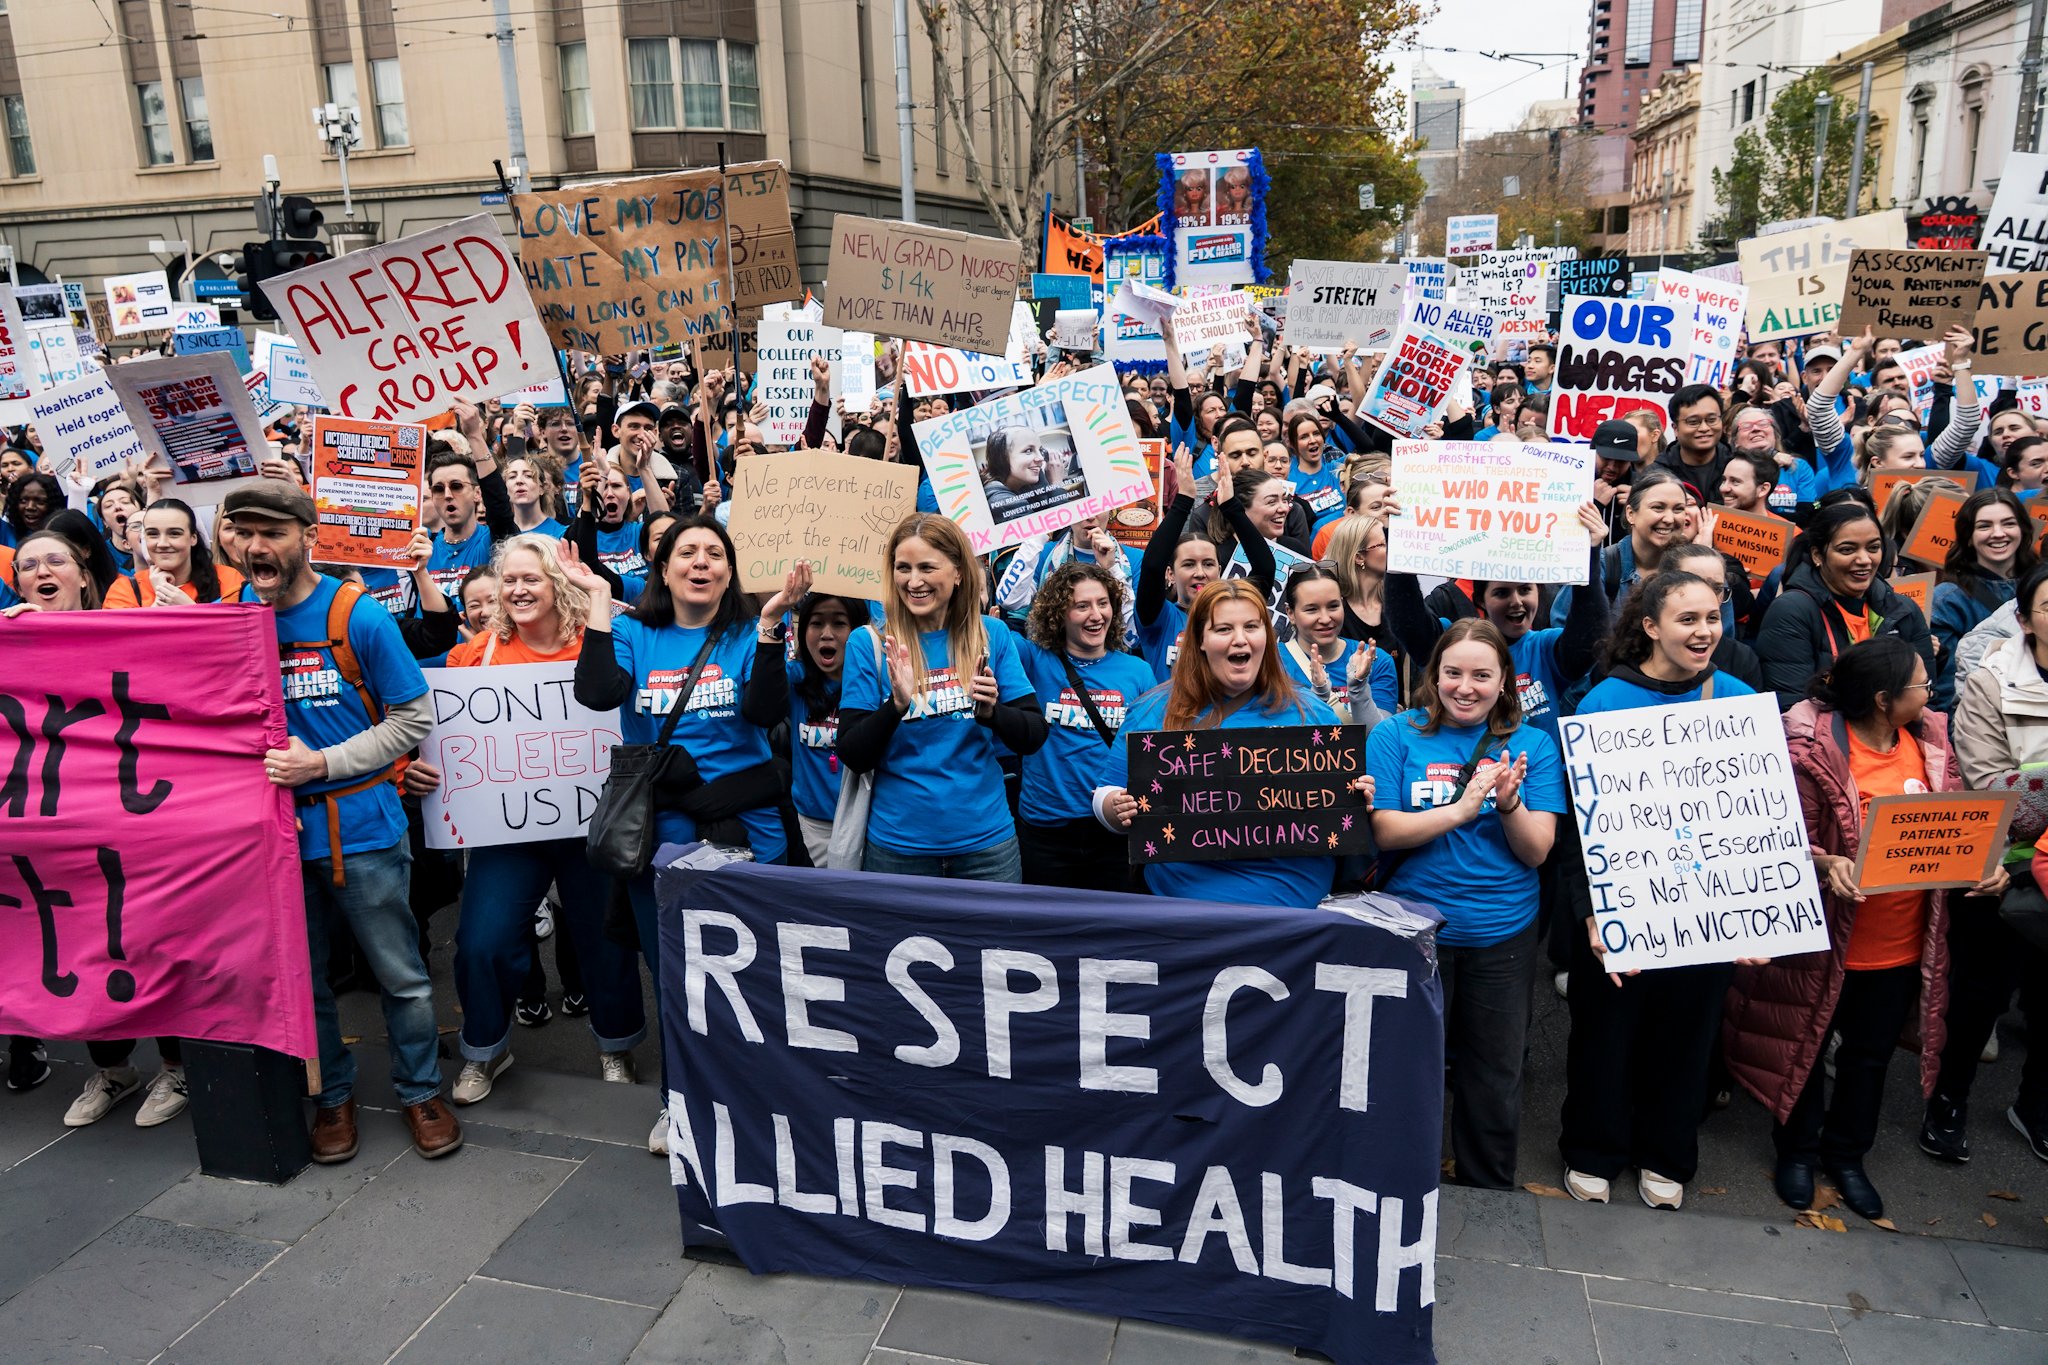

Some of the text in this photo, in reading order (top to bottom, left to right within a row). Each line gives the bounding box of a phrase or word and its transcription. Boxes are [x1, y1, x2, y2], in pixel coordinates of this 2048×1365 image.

[515, 186, 722, 239] LOVE MY JOB
[1220, 214, 1240, 225] 19%
[1216, 242, 1241, 251] ALLIED
[1216, 248, 1242, 257] HEALTH
[526, 236, 720, 291] HATE MY PAY
[843, 233, 1016, 282] NEW GRAD NURSES
[1481, 253, 1496, 265] Do
[1850, 251, 1984, 273] ASSESSMENT:
[1481, 267, 1525, 279] what an
[1561, 258, 1620, 279] BEHIND
[1428, 275, 1445, 287] PAY
[1561, 276, 1611, 295] EVERY
[1797, 275, 1826, 296] IS
[287, 236, 509, 354] ALFRED
[1202, 294, 1245, 310] PATIENTS
[1313, 287, 1376, 307] STRETCH
[1423, 289, 1444, 300] BILLS
[1480, 297, 1507, 306] This
[1858, 295, 1961, 308] PLAN NEEDS
[587, 288, 693, 324] LONG CAN
[837, 296, 934, 326] MORE THAN
[1226, 306, 1247, 319] OUR
[1414, 303, 1494, 327] NO ALLIED
[188, 311, 206, 324] NO
[1572, 300, 1675, 349] OUR
[1878, 308, 1933, 329] REHAB
[618, 320, 669, 347] THIS
[787, 329, 814, 342] OUR
[1201, 324, 1234, 339] SHOULD
[1444, 321, 1492, 338] HEALTH
[368, 315, 472, 371] CARE
[949, 334, 964, 347] year
[1420, 340, 1450, 359] SAFE
[1399, 343, 1459, 378] WORK
[1557, 344, 1686, 394] WAGES
[773, 368, 796, 380] ARE
[1390, 357, 1452, 392] LOADS
[139, 376, 212, 399] WE'RE NOT
[169, 385, 217, 400] SUPPORT
[1381, 370, 1445, 408] NOW
[33, 386, 104, 419] Healthcare
[149, 392, 223, 420] STAFF
[769, 406, 784, 418] TO
[56, 419, 85, 436] Held
[772, 422, 804, 430] WE ARE
[920, 381, 1120, 457] DESERVE RESPECT!
[325, 431, 390, 450] VICTORIAN MEDICAL
[95, 453, 117, 469] and
[338, 446, 375, 461] SCIENTISTS
[391, 449, 416, 465] CRISIS
[1396, 442, 1585, 469] PHYSIO ORTHOTICS PODIATRISTS
[1438, 454, 1511, 465] PROSTHETICS
[1404, 464, 1548, 478] OCCUPATIONAL THERAPISTS
[318, 488, 352, 496] GOVERNMENT
[744, 465, 904, 499] We prevent falls
[1006, 476, 1084, 505] REALISING THE
[1394, 479, 1575, 503] SOCIAL WHO ARE ART
[1541, 492, 1582, 503] THERAPY
[335, 514, 395, 528] EXPERIENCED SCIENTISTS
[1002, 481, 1148, 544] ALLIED HEALTH
[1003, 504, 1040, 518] LOWEST PAID
[1415, 506, 1460, 528] WE
[1466, 508, 1492, 531] TO
[733, 527, 868, 554] except the fall
[1394, 529, 1447, 542] SPIRITUAL
[1500, 537, 1553, 552] SPEECH
[1722, 521, 1778, 541] BACKPAY IS
[1402, 542, 1431, 551] CARE
[1716, 533, 1780, 557] THE MISSING
[750, 558, 789, 578] our
[1393, 555, 1585, 581] EXERCISE PHYSIOLOGISTS
[1734, 552, 1757, 565] UNIT
[280, 657, 320, 668] BAND AIDS
[287, 669, 338, 688] ALLIED
[649, 674, 683, 684] NO MORE
[287, 682, 339, 699] HEALTH
[1105, 694, 1121, 703] AIDS
[312, 699, 339, 707] VAHPA
[709, 709, 735, 718] VAHPA
[1664, 714, 1756, 745] Explain
[1158, 745, 1357, 777] SAFE DECISIONS
[1663, 752, 1782, 788] Profession
[1427, 768, 1459, 777] NO MORE
[502, 788, 560, 830] US
[1182, 786, 1336, 814] NEED SKILLED
[1630, 788, 1788, 830] Rely on Daily
[1891, 811, 1989, 824] ESSENTIAL FOR
[1192, 821, 1320, 849] CLINICIANS
[1699, 822, 1803, 861] Essential
[1900, 828, 1961, 841] PATIENTS
[1886, 845, 1974, 859] ESSENTIAL TO
[1909, 863, 1940, 874] PAY!
[1696, 861, 1801, 898] VALUED
[1696, 898, 1823, 943] VICTORIA!
[681, 909, 1408, 1112] RESPECT
[667, 1089, 1438, 1312] ALLIED HEALTH
